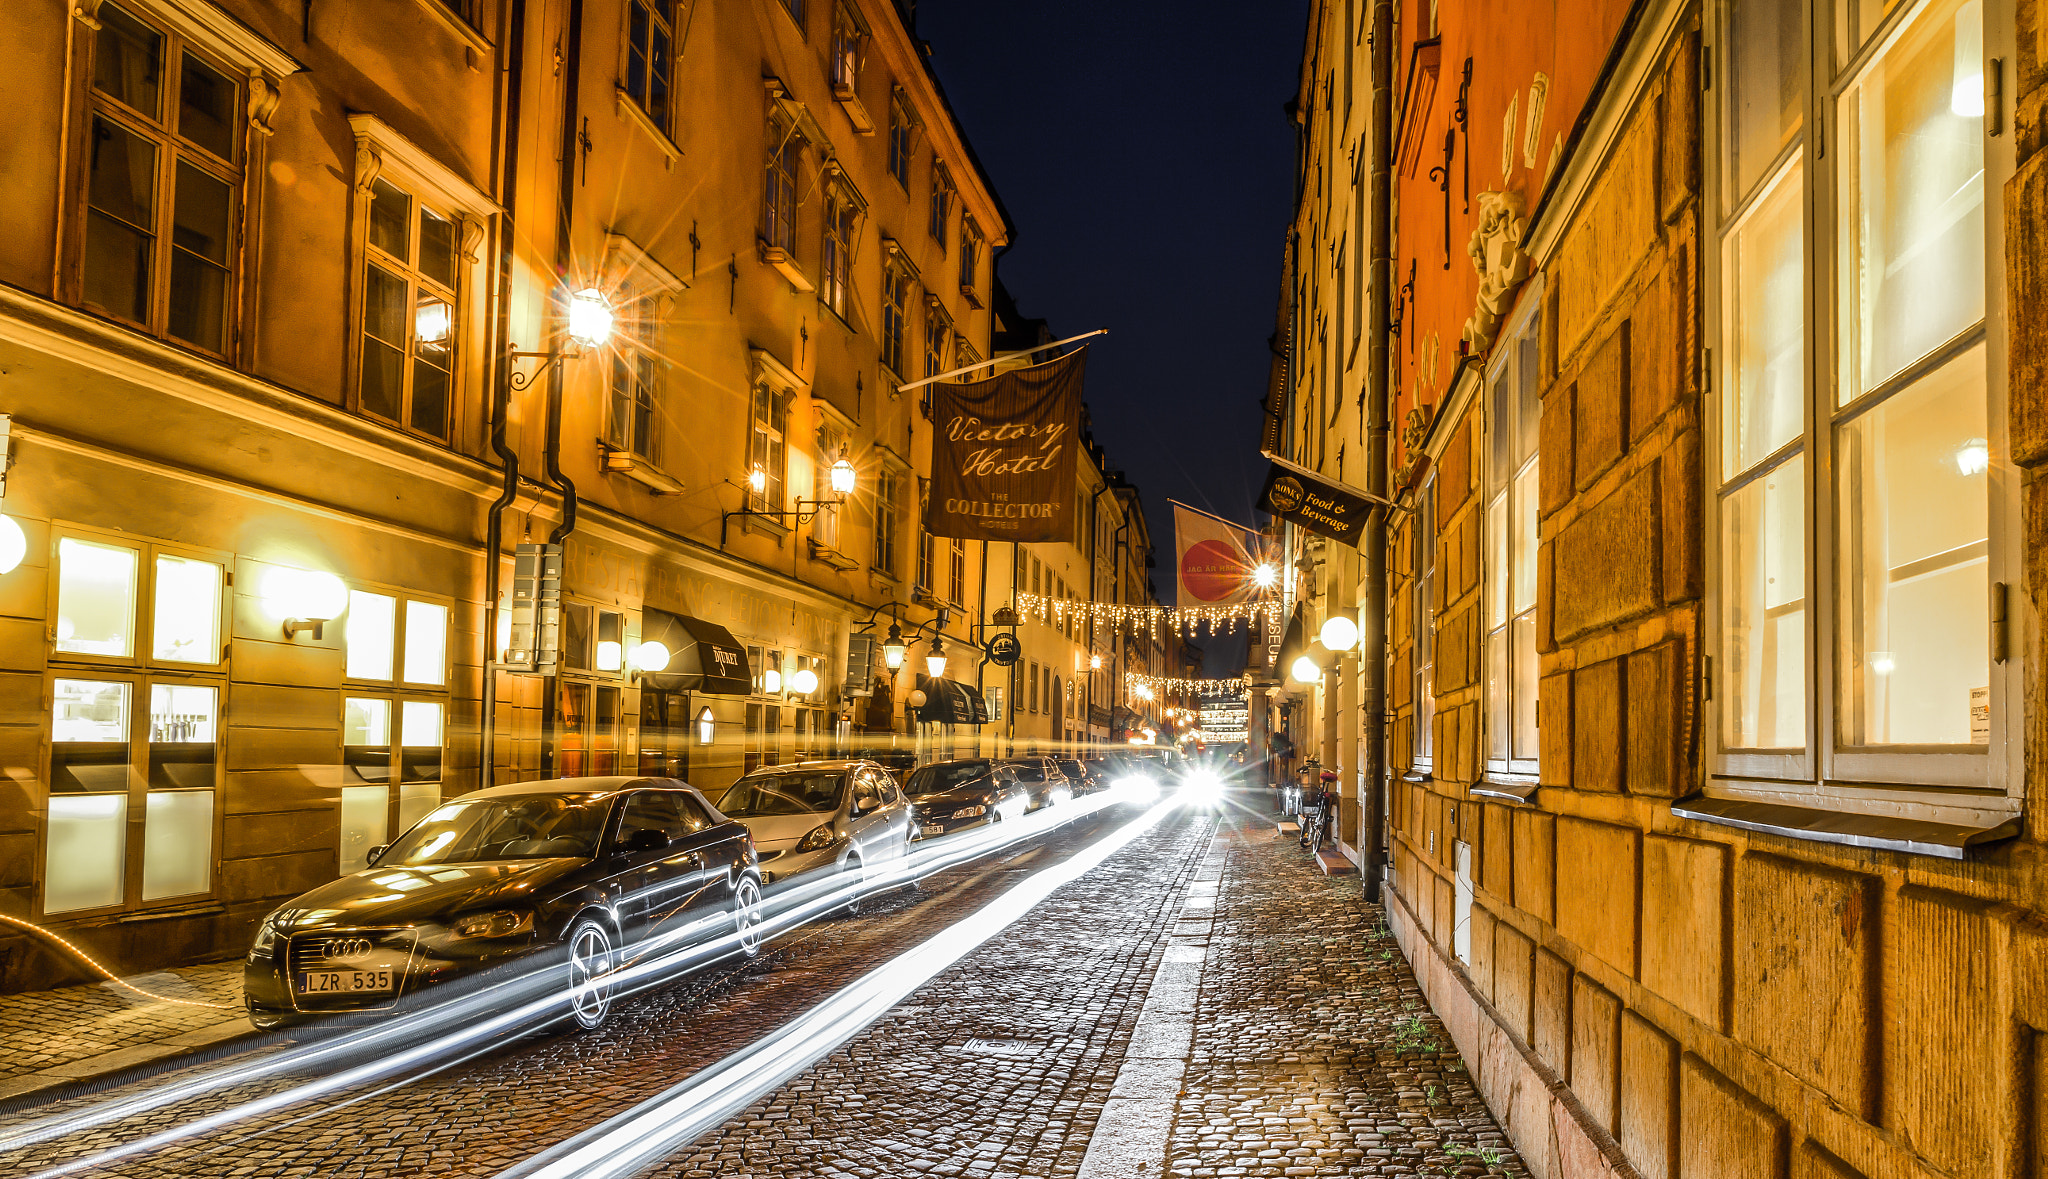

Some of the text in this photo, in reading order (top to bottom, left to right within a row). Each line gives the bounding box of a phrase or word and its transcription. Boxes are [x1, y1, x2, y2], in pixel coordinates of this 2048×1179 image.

[945, 416, 1070, 450] Victory
[962, 444, 1062, 477] Hotel
[991, 492, 1009, 502] THE
[1306, 492, 1346, 514] Food &
[979, 521, 1019, 530] HOTELS
[1300, 504, 1349, 532] Beverage
[564, 538, 714, 617] RESTAURANG
[1205, 564, 1217, 572] ÄR
[928, 826, 942, 834] 581
[309, 971, 388, 991] LZR 535
